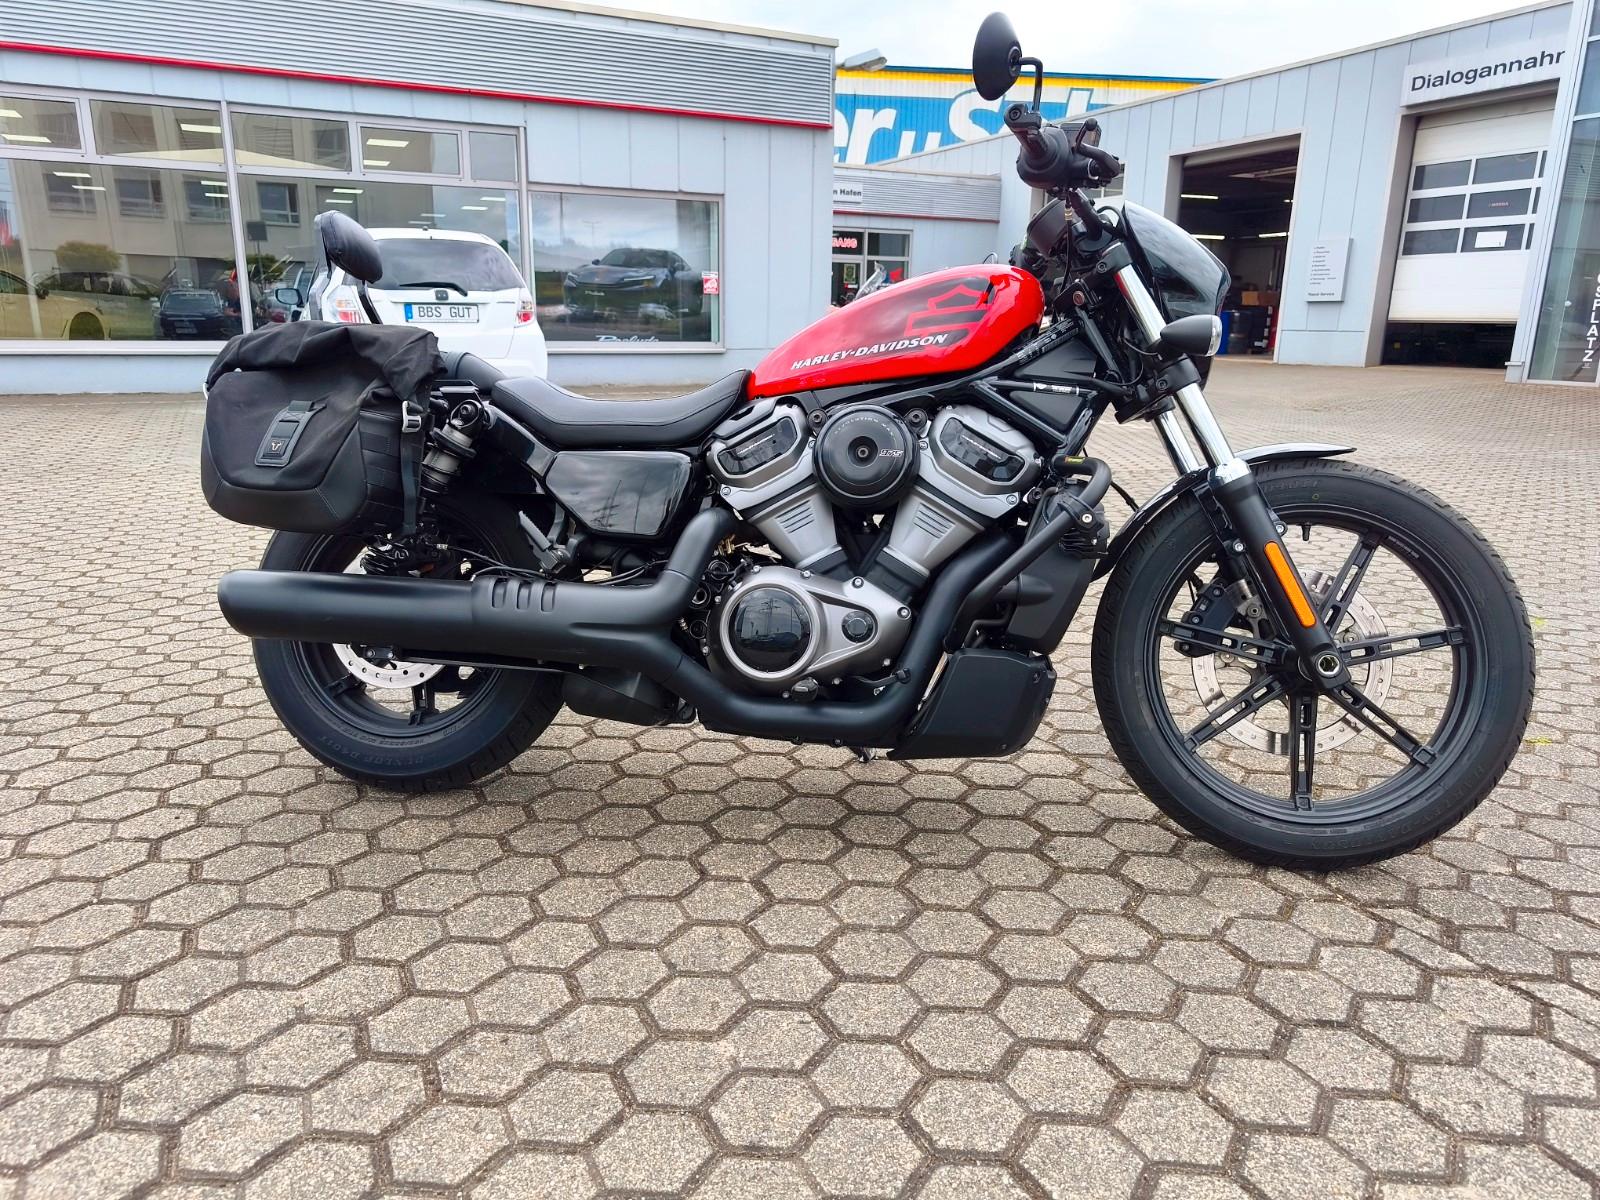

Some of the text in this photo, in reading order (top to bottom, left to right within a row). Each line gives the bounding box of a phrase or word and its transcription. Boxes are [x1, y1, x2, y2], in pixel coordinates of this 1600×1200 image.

[417, 306, 473, 318] BBS GUT
[791, 333, 948, 370] HARLEY-DAVIDSON
